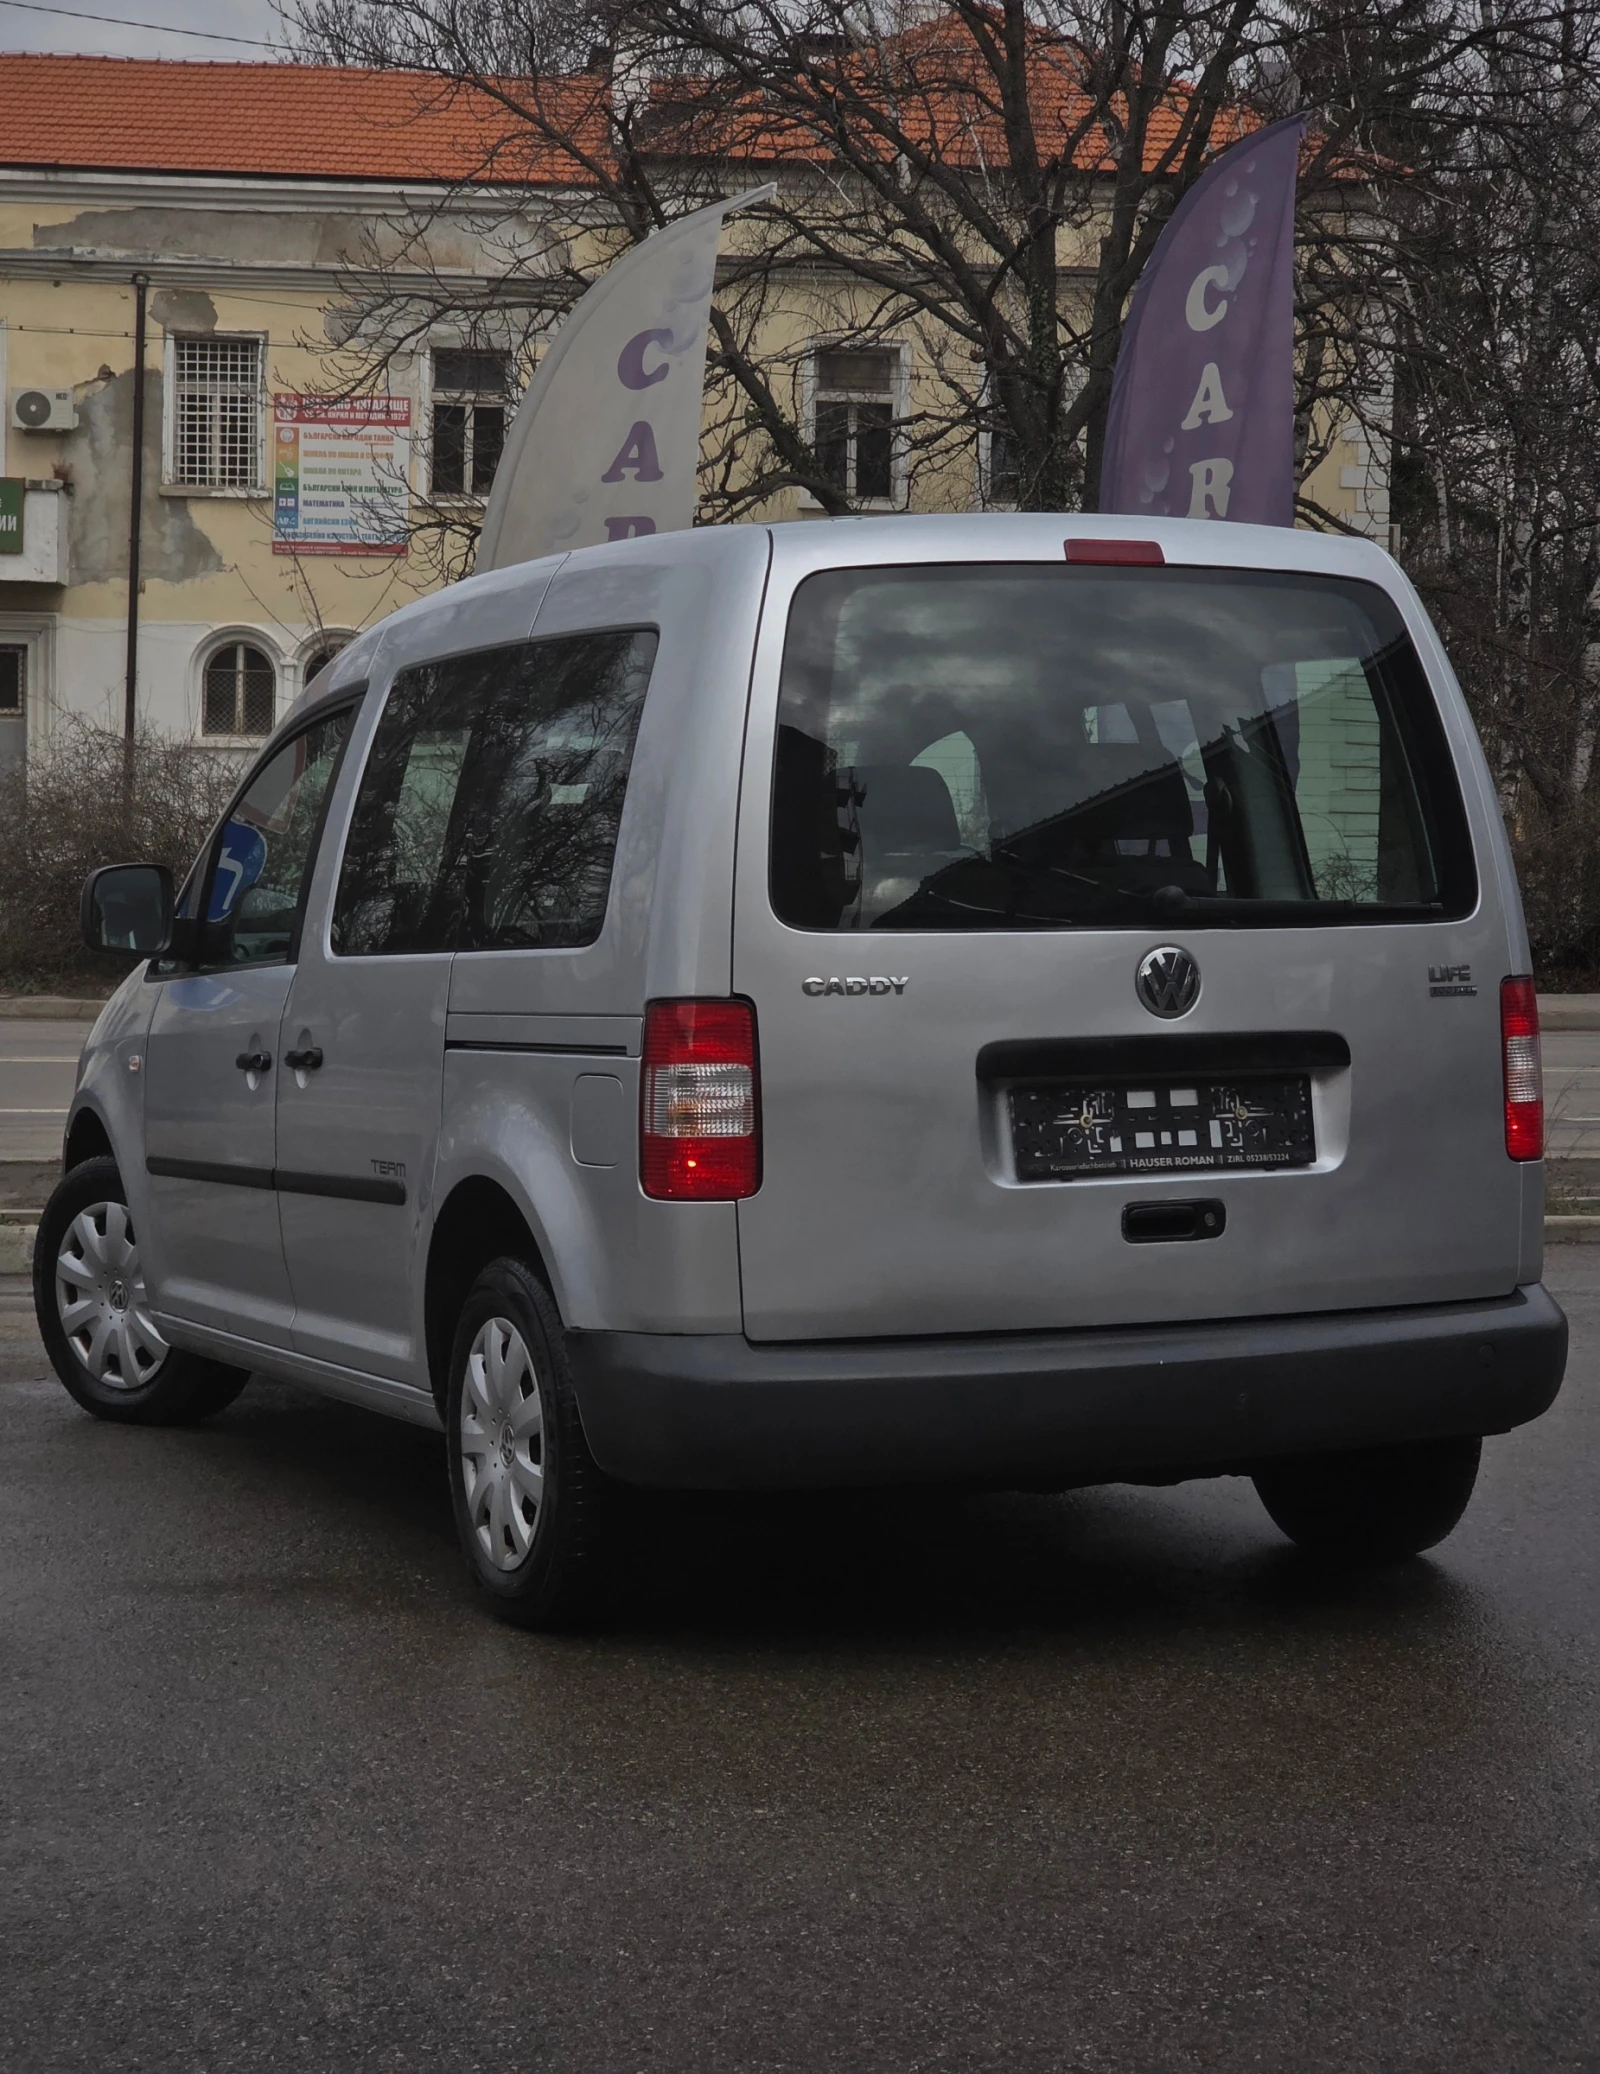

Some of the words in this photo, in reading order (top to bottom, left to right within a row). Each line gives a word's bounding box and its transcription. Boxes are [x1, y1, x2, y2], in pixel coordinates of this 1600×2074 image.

[1181, 265, 1234, 519] CAR
[303, 499, 345, 508] МАТЕМАТИКА
[1428, 964, 1471, 983] LIFE
[802, 976, 909, 997] CADDY
[370, 1158, 406, 1178] TEAM
[1050, 1161, 1117, 1172] Karosseriefachbetrieb
[1130, 1157, 1173, 1168] HAUSER
[1175, 1155, 1215, 1167] ROMAN
[1227, 1154, 1245, 1163] ZIRL
